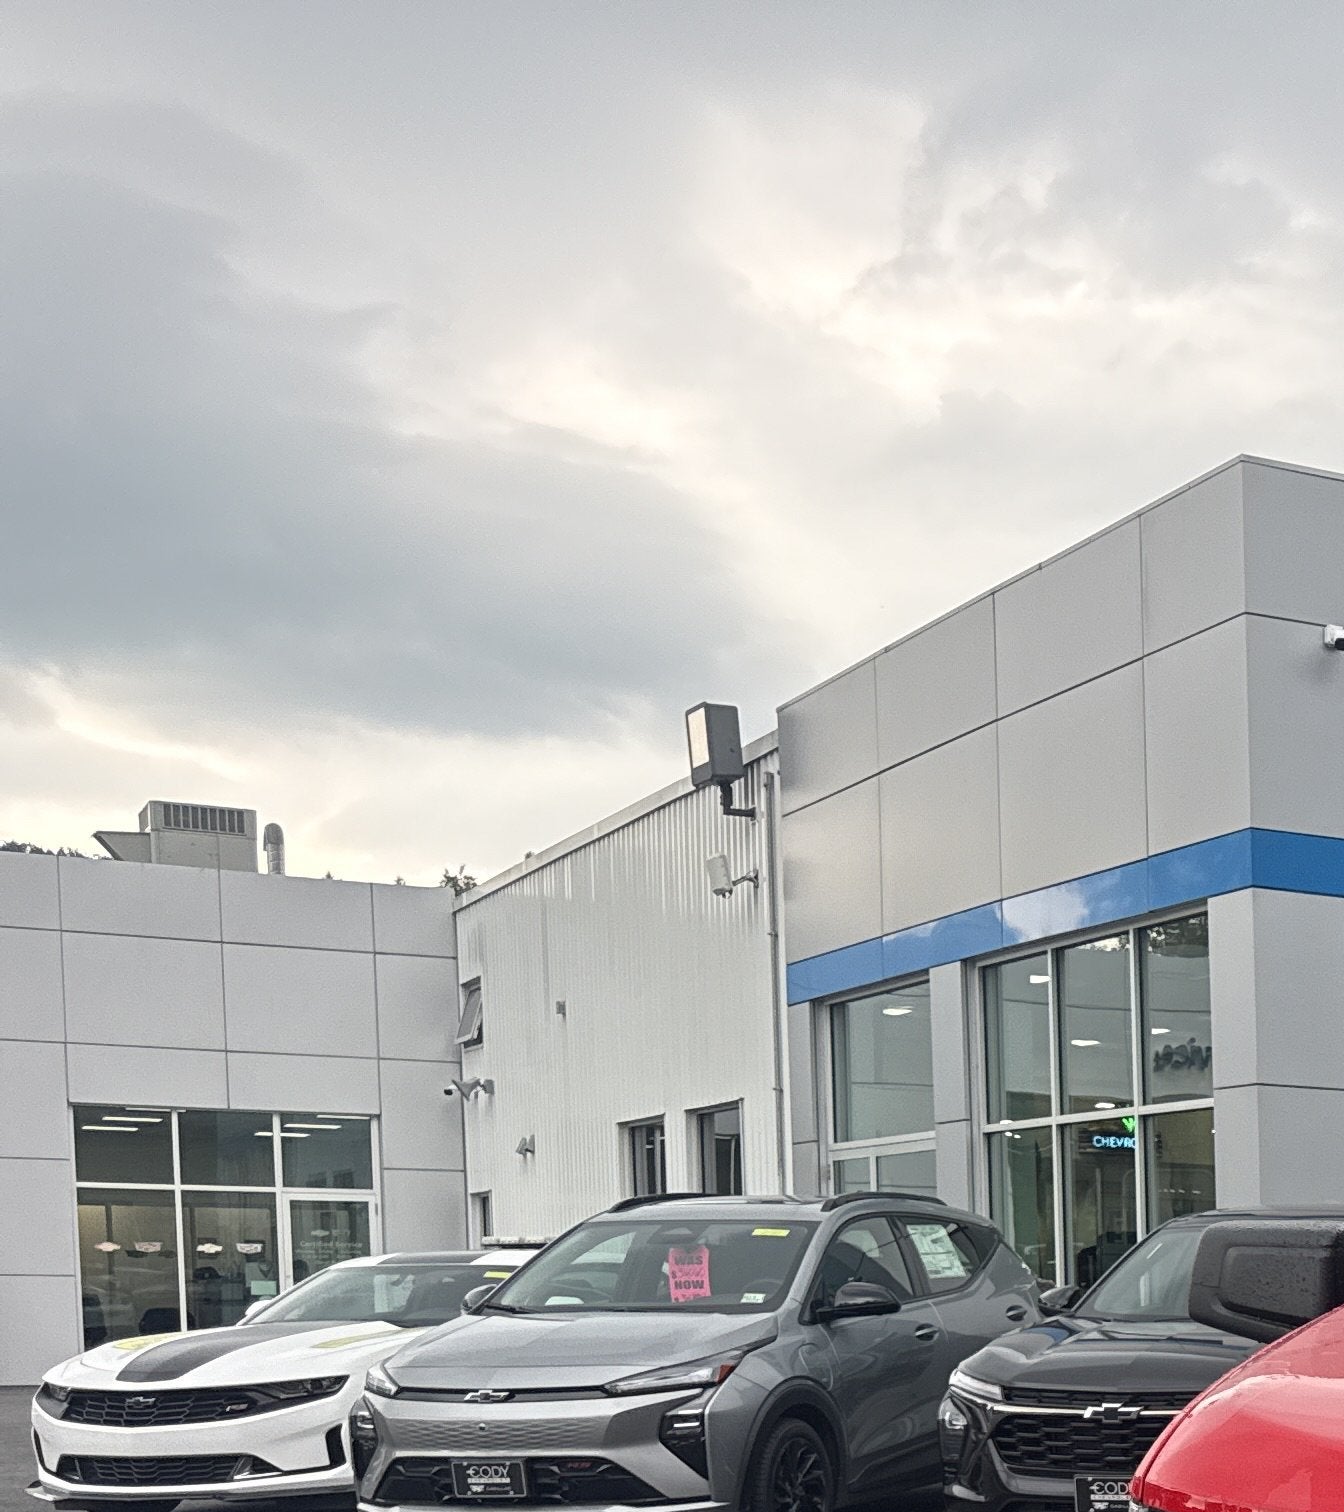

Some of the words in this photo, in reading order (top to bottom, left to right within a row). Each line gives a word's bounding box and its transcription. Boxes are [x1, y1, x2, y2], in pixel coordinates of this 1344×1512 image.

[674, 1279, 705, 1290] NOW
[467, 1465, 509, 1478] CODY
[1091, 1481, 1131, 1495] COD
